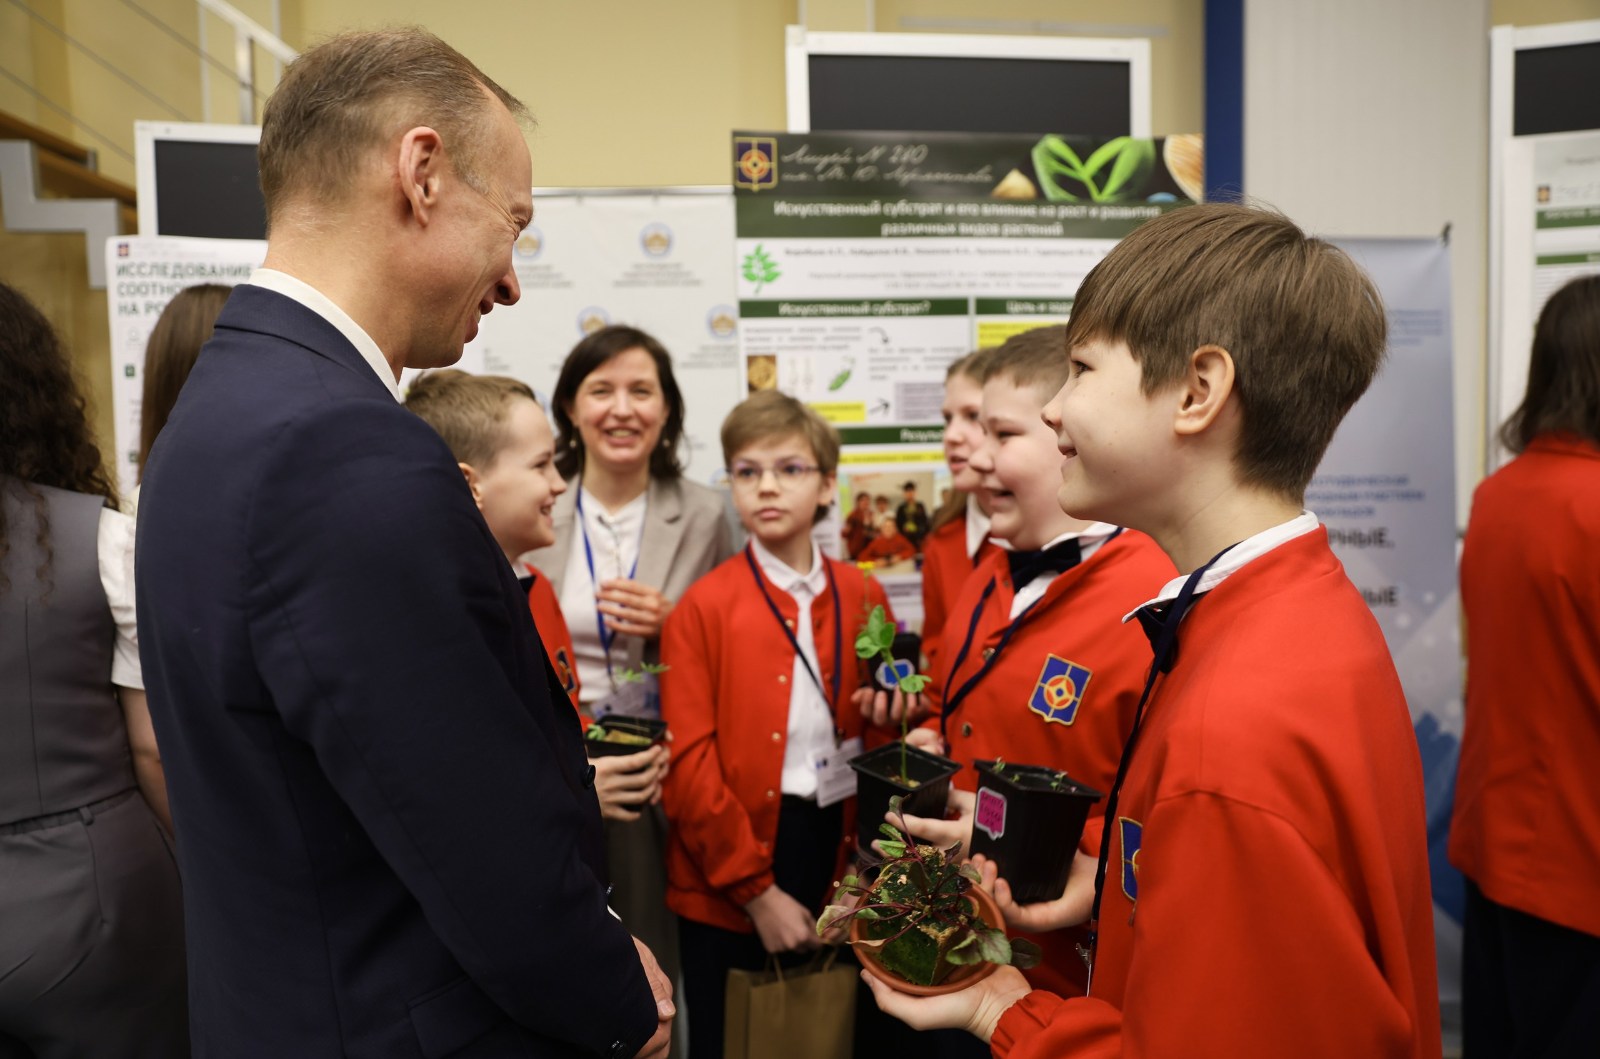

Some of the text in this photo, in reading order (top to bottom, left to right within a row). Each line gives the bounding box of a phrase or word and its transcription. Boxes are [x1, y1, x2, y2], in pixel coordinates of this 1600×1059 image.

[773, 199, 1162, 221] Искусственный субстрат и его влияние на рост и развитие
[881, 221, 1064, 237] различных видов растений
[116, 263, 252, 278] ИССЛЕДОВАНИЕ
[118, 304, 139, 316] НА
[779, 300, 932, 317] Искусственный субстрат?
[1006, 301, 1037, 315] Цель
